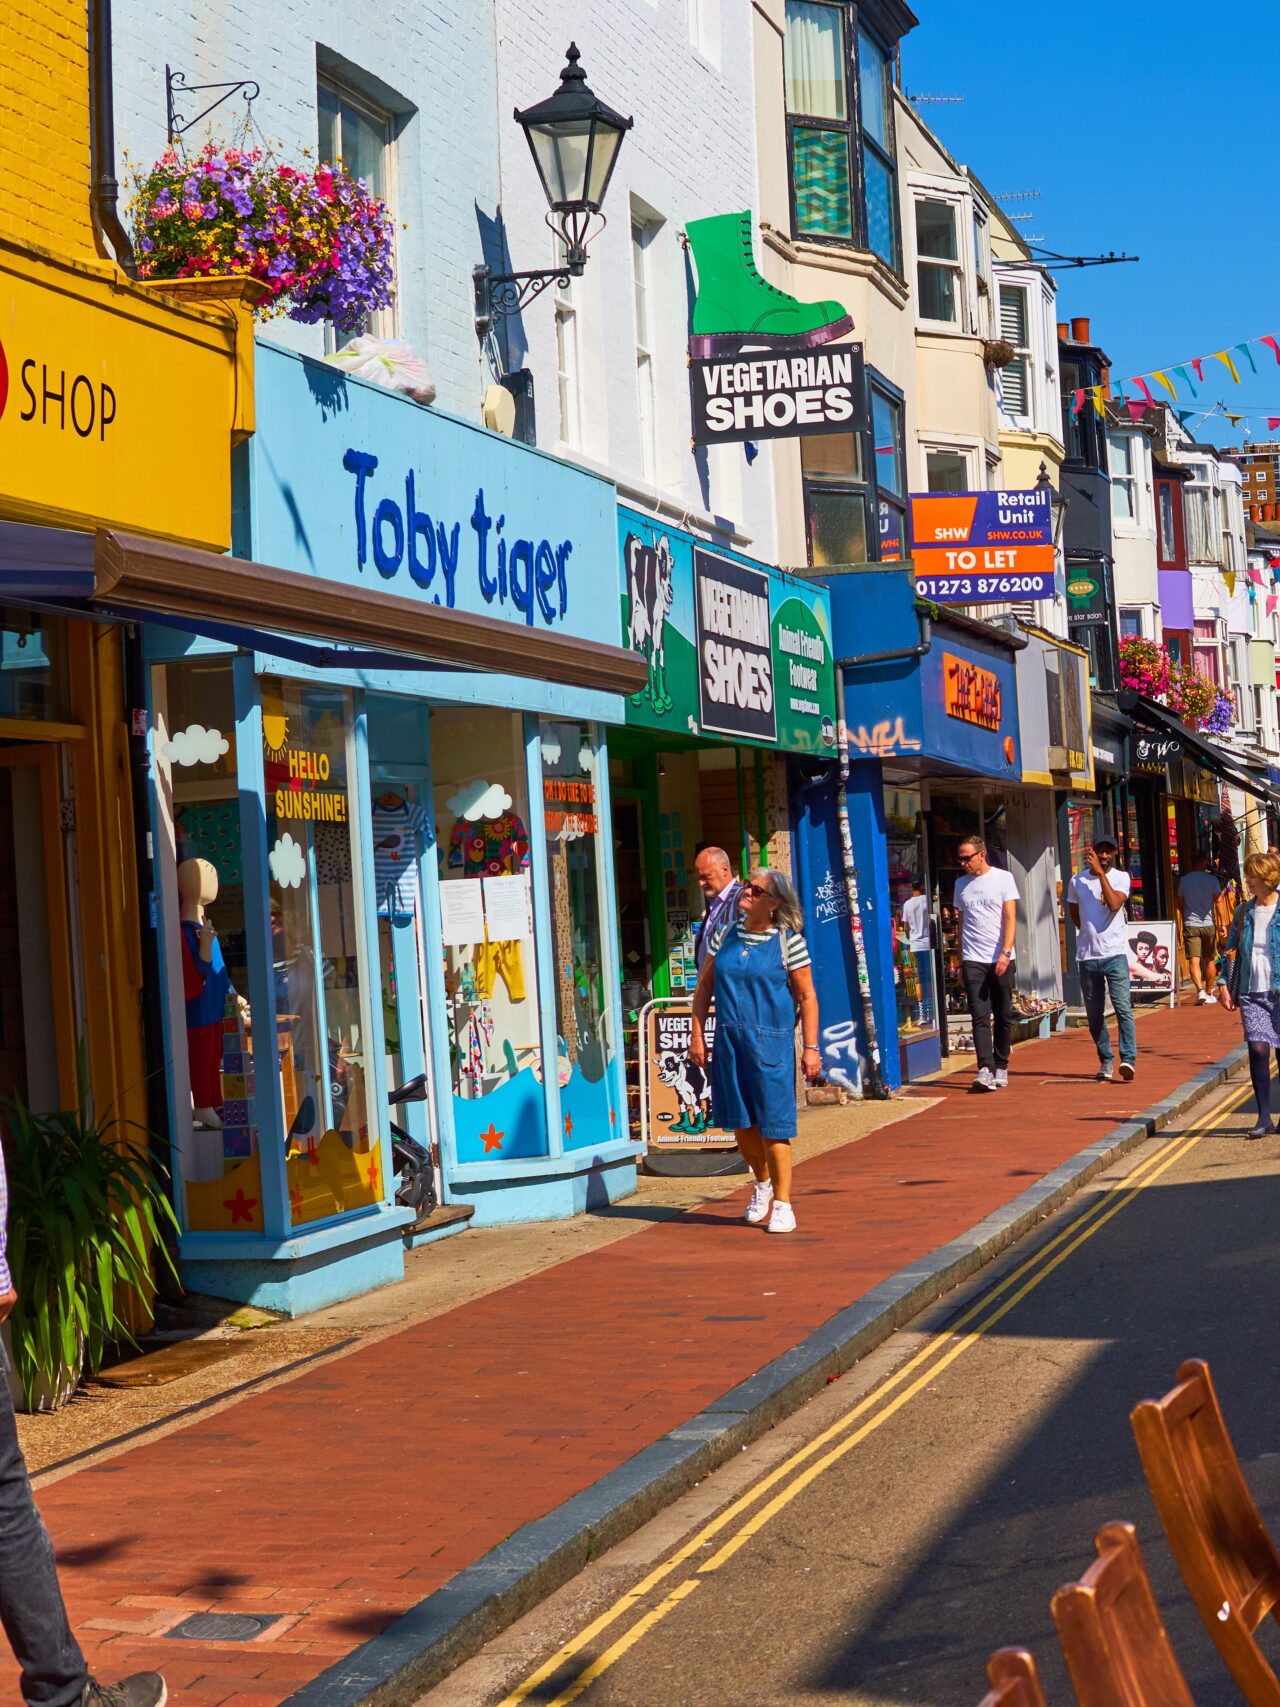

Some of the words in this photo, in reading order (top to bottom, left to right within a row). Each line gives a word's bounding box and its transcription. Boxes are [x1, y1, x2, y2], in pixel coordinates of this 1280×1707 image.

[702, 353, 852, 395] VEGETARIAN
[21, 359, 116, 441] SHOP
[705, 387, 854, 432] SHOES
[997, 490, 1046, 507] Retail
[998, 509, 1034, 525] Unit
[343, 448, 460, 608] Toby
[471, 488, 573, 626] tiger
[935, 528, 969, 541] SHW
[987, 528, 1043, 540] SHW.CO.UK
[946, 552, 973, 570] TO
[985, 550, 1018, 569] LET
[916, 578, 971, 596] 01273
[977, 576, 1044, 593] 876200
[700, 576, 770, 649] VEGETARIAN
[1087, 612, 1103, 621] salon
[800, 630, 825, 665] Friendly
[705, 639, 772, 713] SHOES
[789, 658, 818, 692] Footwear
[288, 750, 330, 781] HELLO
[275, 791, 346, 822] SUNSHINE!
[658, 1135, 706, 1144] Animal-Friendly
[707, 1135, 736, 1143] Footwear
